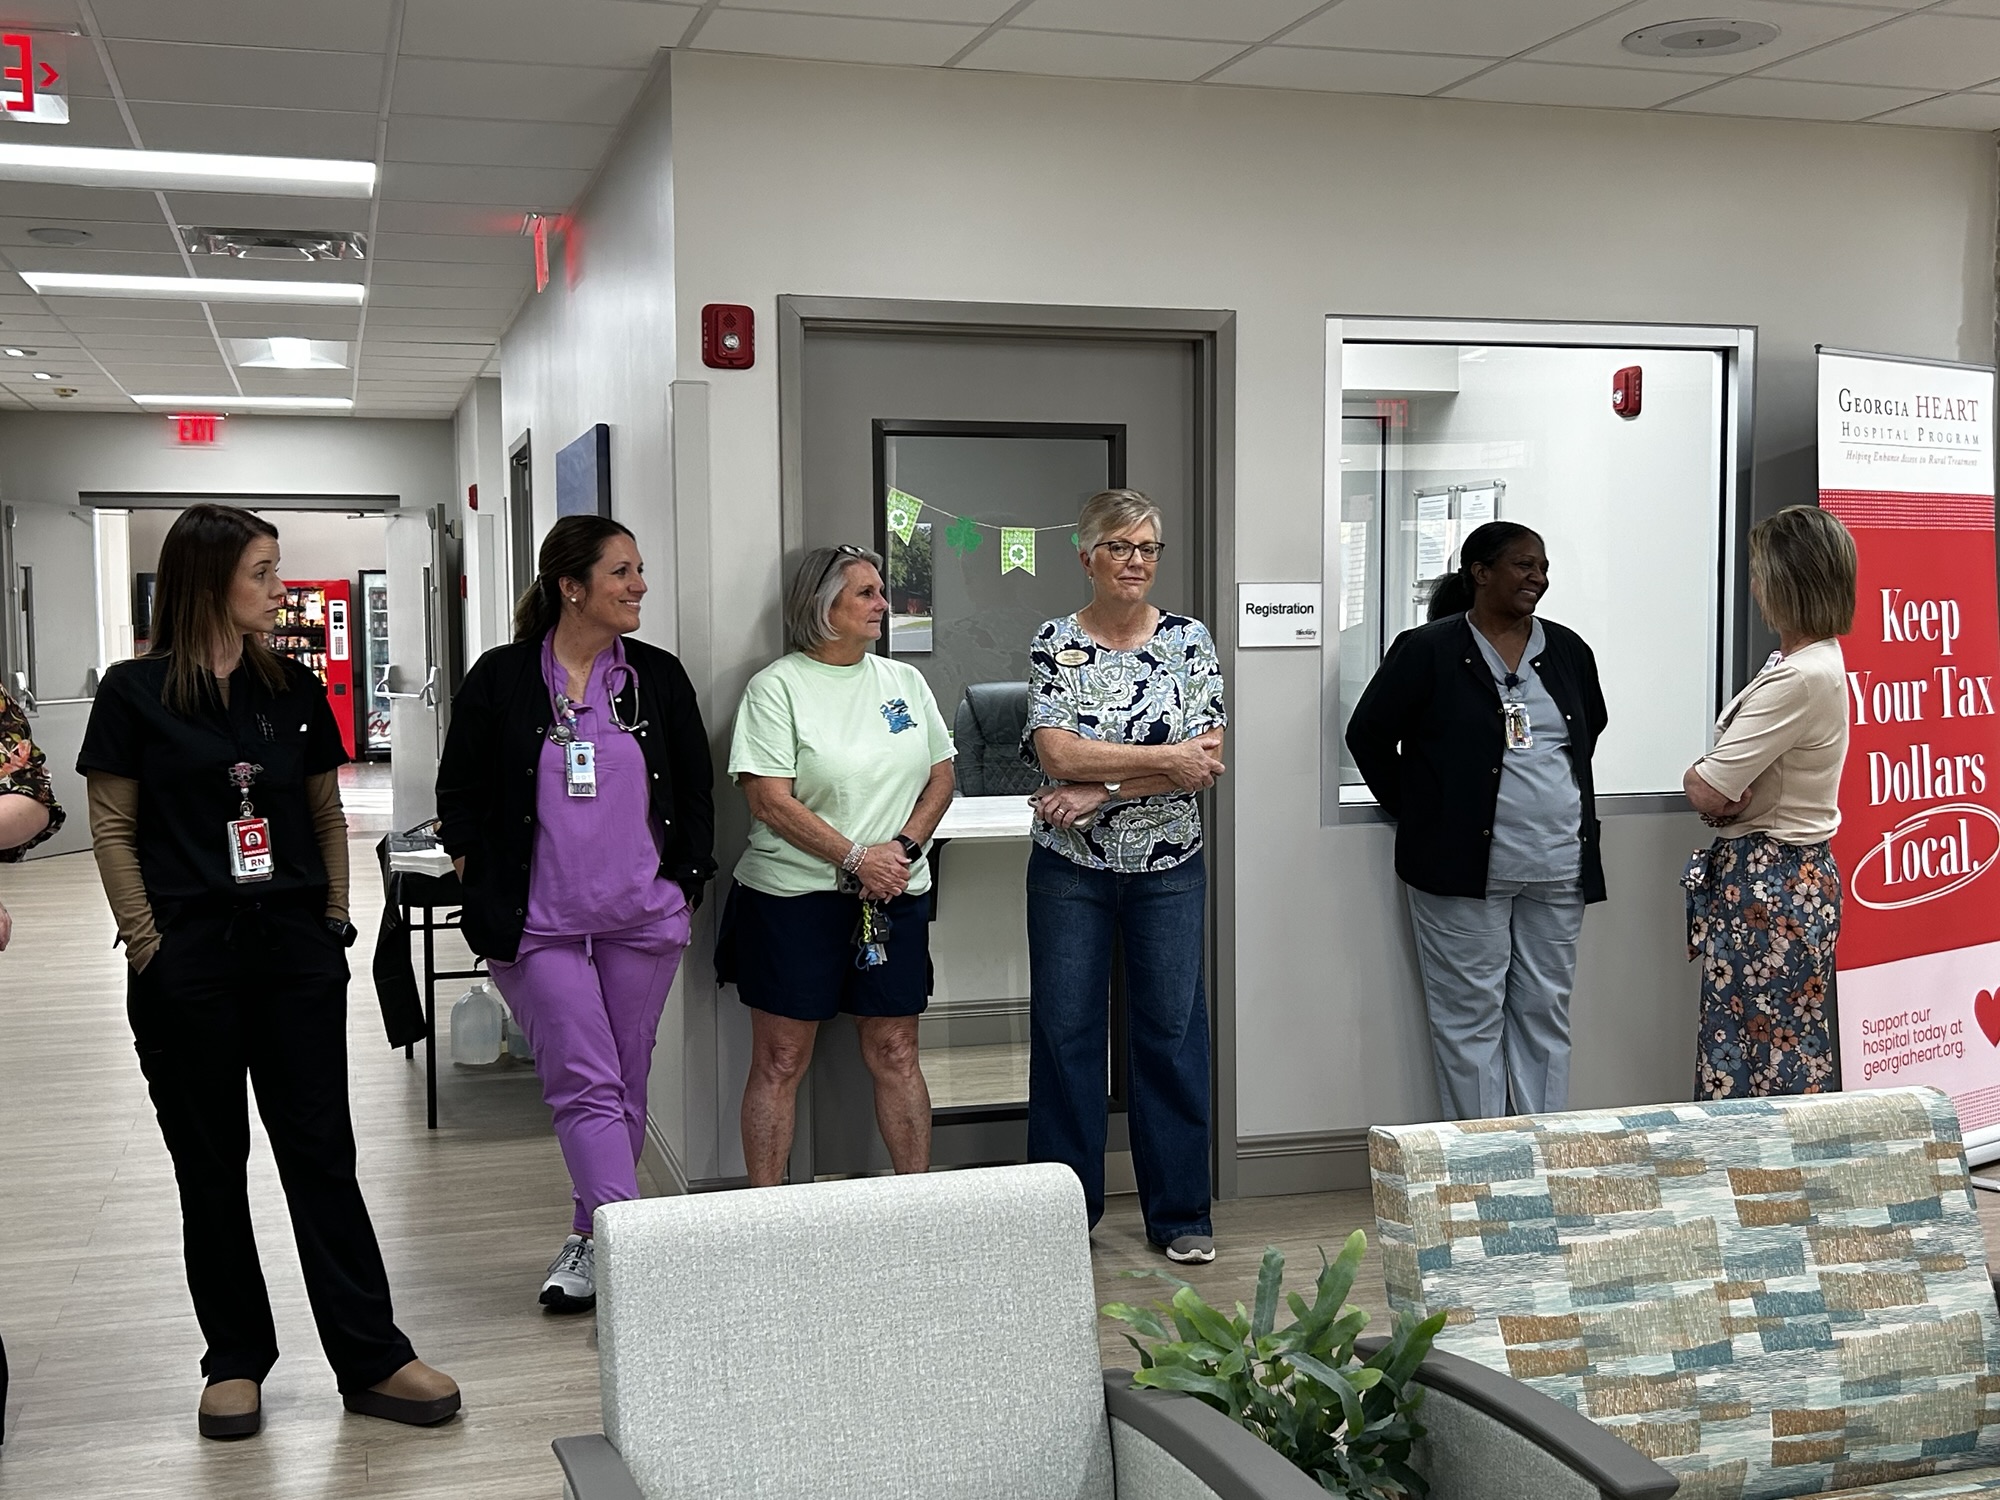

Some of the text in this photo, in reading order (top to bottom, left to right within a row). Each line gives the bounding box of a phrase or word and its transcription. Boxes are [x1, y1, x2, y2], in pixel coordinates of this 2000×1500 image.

[1916, 395, 1978, 422] HEART
[179, 418, 214, 442] EXIT
[1846, 450, 1978, 467] Helping Enhance Access to Rural Treatment
[1245, 602, 1314, 618] Registration
[1880, 588, 1960, 656] Keep
[1846, 665, 1996, 726] Your Tax
[1866, 743, 1987, 806] Dollars
[251, 858, 265, 867] RN
[1881, 818, 1980, 886] Local.
[1862, 1008, 1931, 1036] Support our
[1863, 1019, 1963, 1056] hospital today at
[1863, 1039, 1966, 1081] georgiaheart.org.
